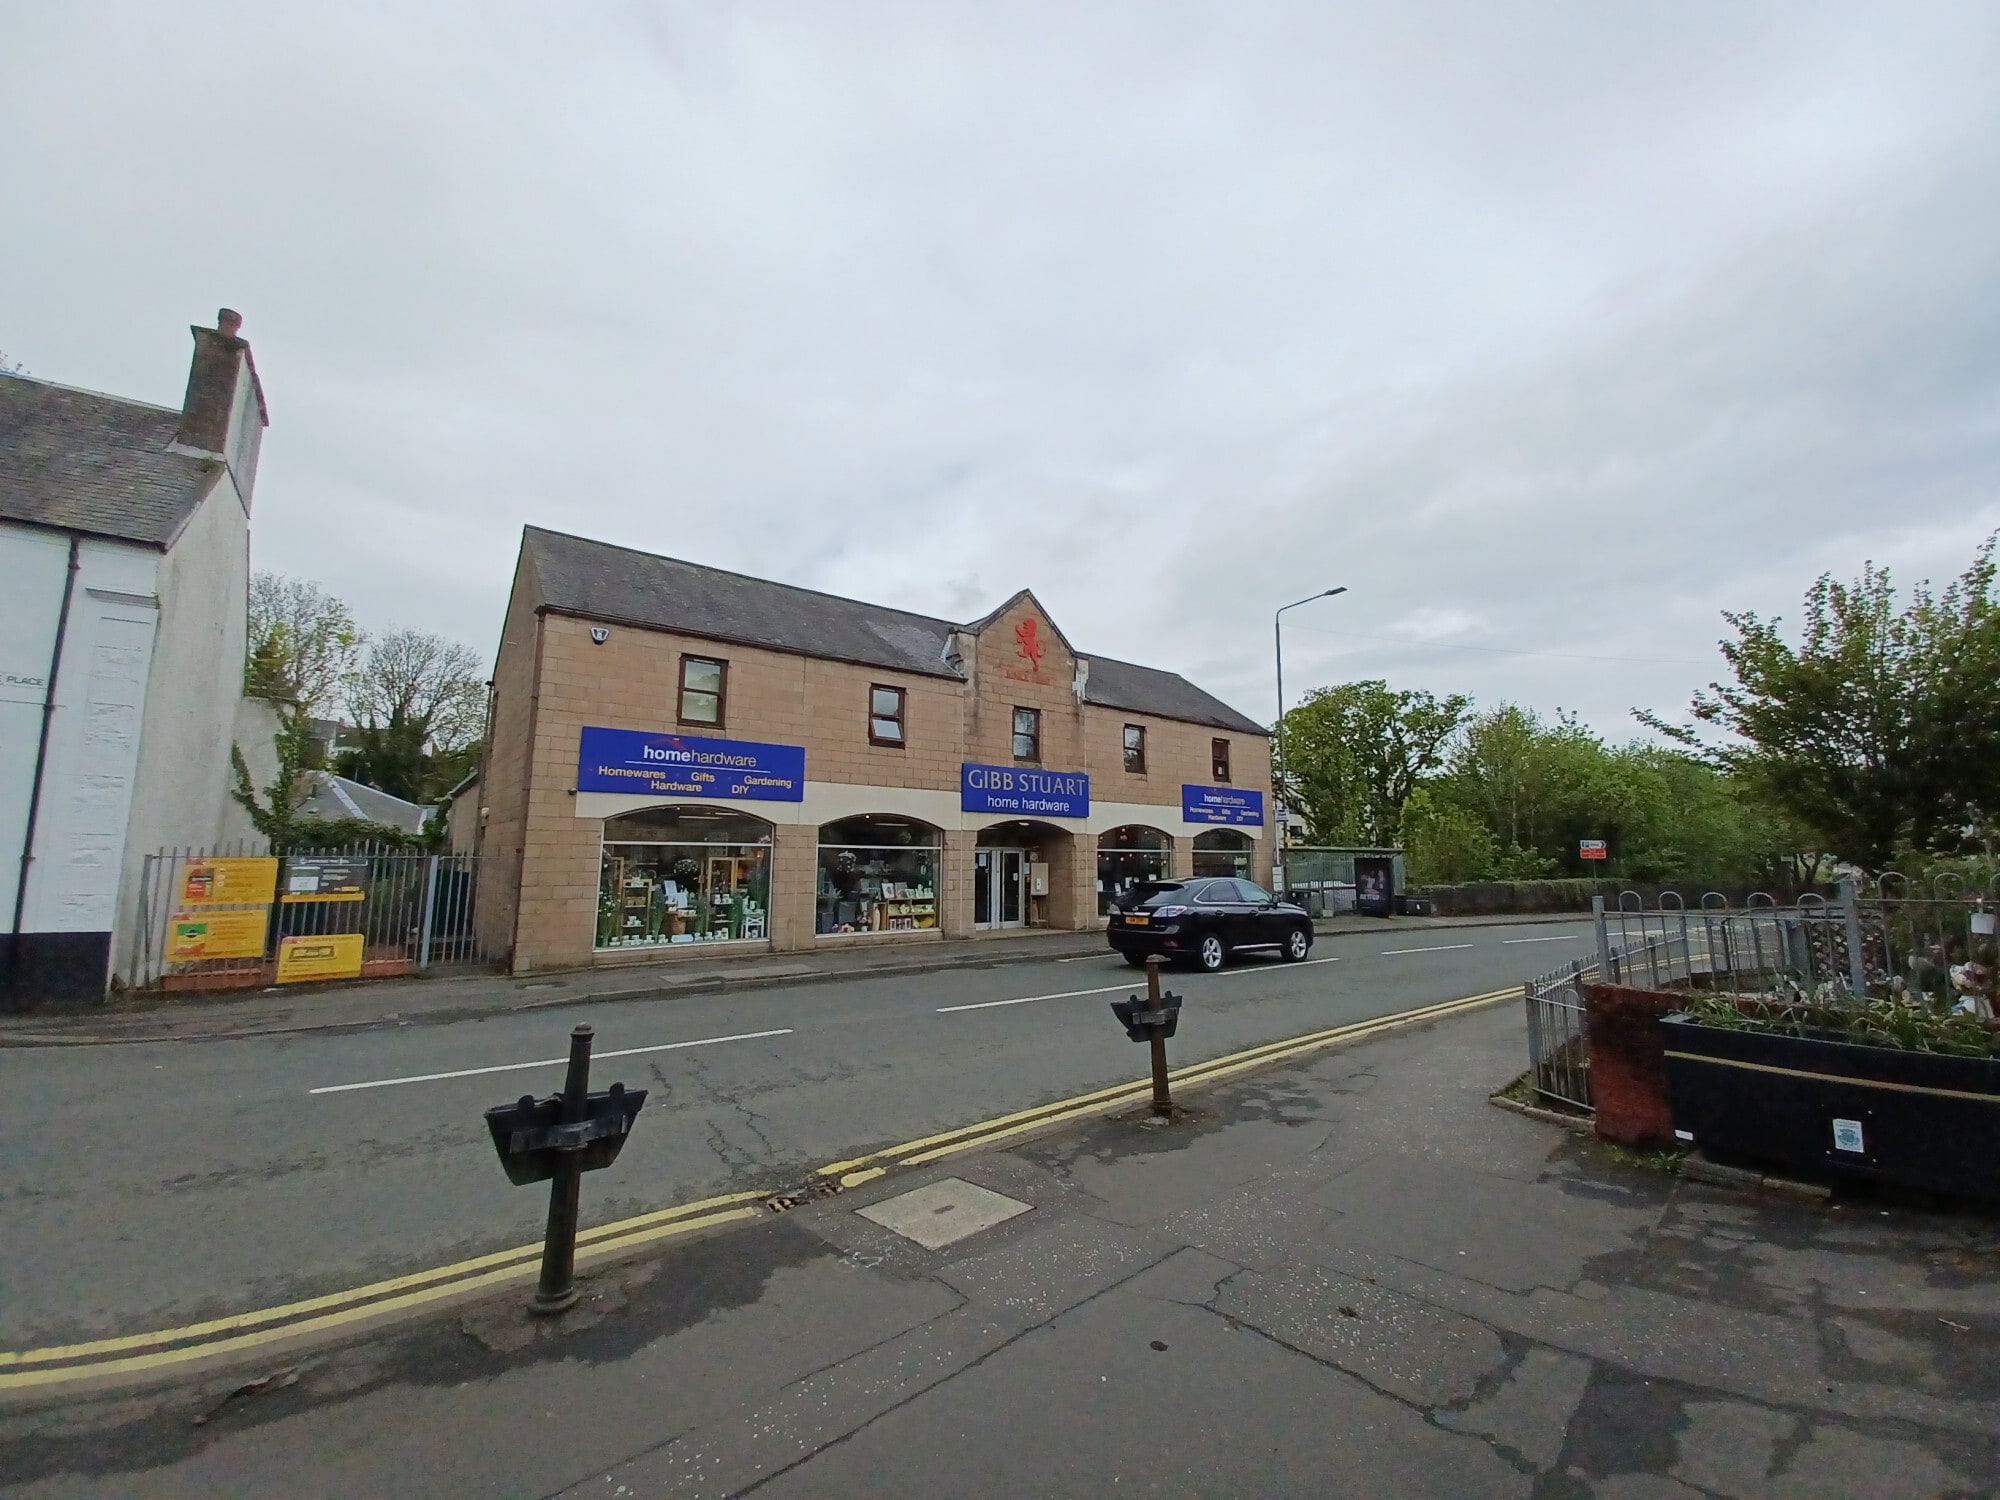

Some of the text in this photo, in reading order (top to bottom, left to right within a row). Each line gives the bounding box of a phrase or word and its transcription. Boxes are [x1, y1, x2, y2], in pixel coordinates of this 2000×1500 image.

[6, 676, 44, 686] PLACE
[643, 745, 757, 767] homehardware
[598, 765, 792, 789] Homewares Gifts Gardening
[968, 769, 1085, 796] GIBB STUART
[651, 780, 749, 794] Hardware DIY
[987, 795, 1070, 812] home hardware
